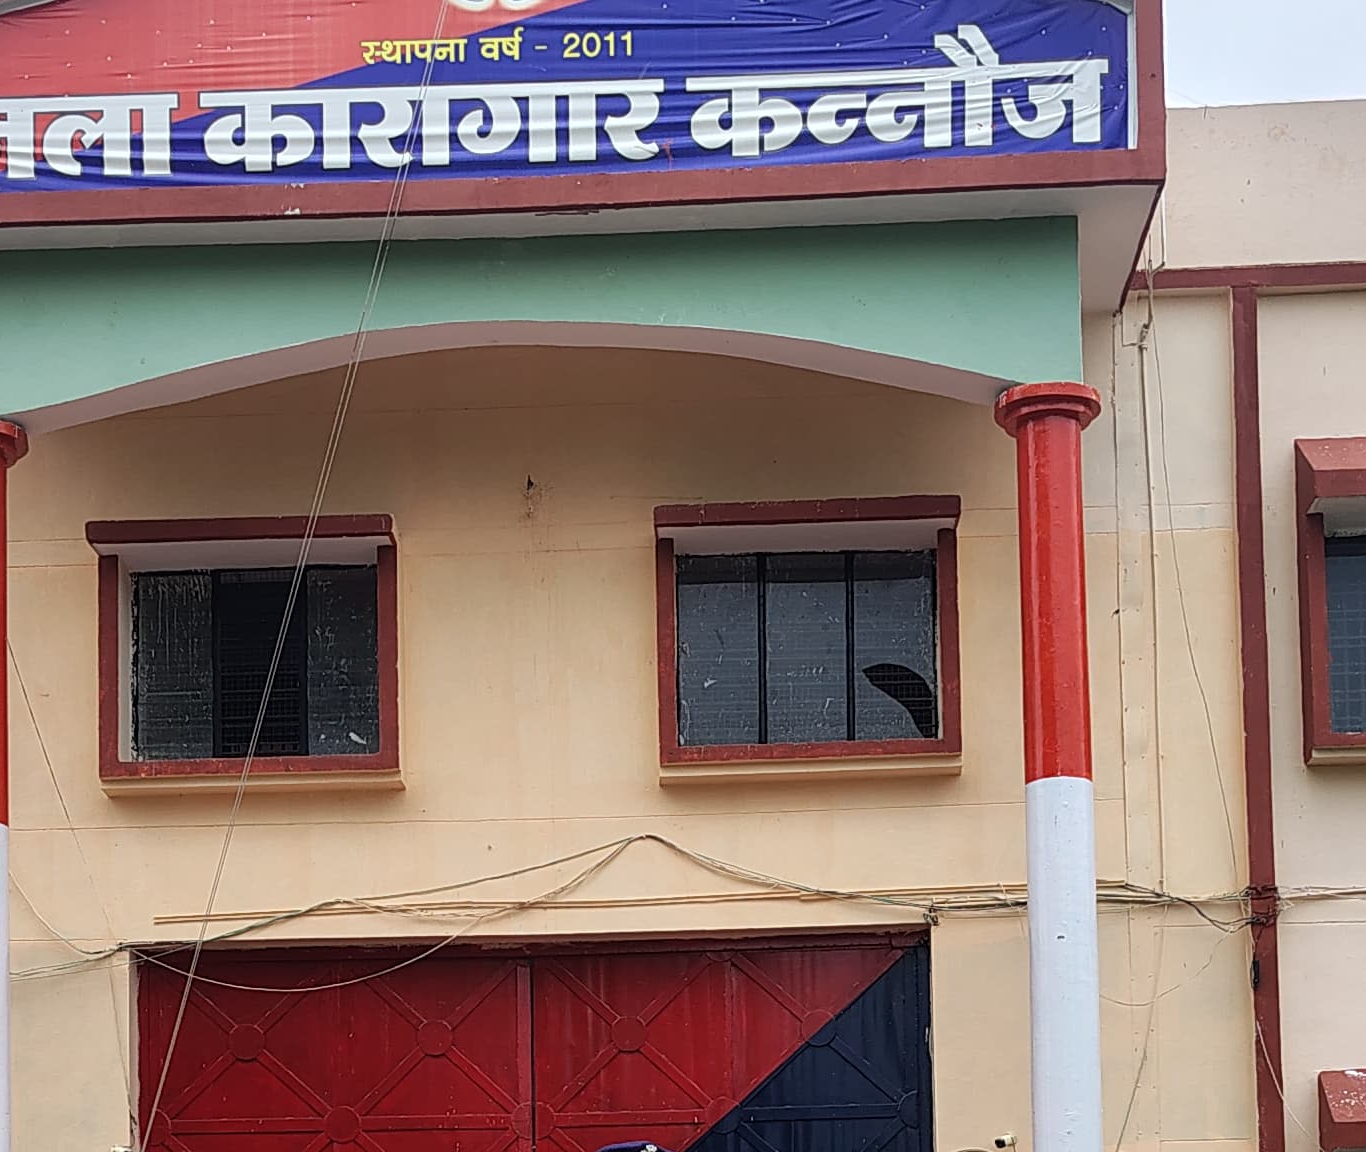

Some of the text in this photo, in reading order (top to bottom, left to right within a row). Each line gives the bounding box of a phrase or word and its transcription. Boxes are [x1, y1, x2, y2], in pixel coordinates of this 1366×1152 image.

[360, 38, 467, 65] स्थापना
[479, 27, 524, 62] वर्ष
[562, 31, 633, 59] 2011
[199, 77, 665, 172] कारागार
[685, 24, 1109, 158] कन्नौज
